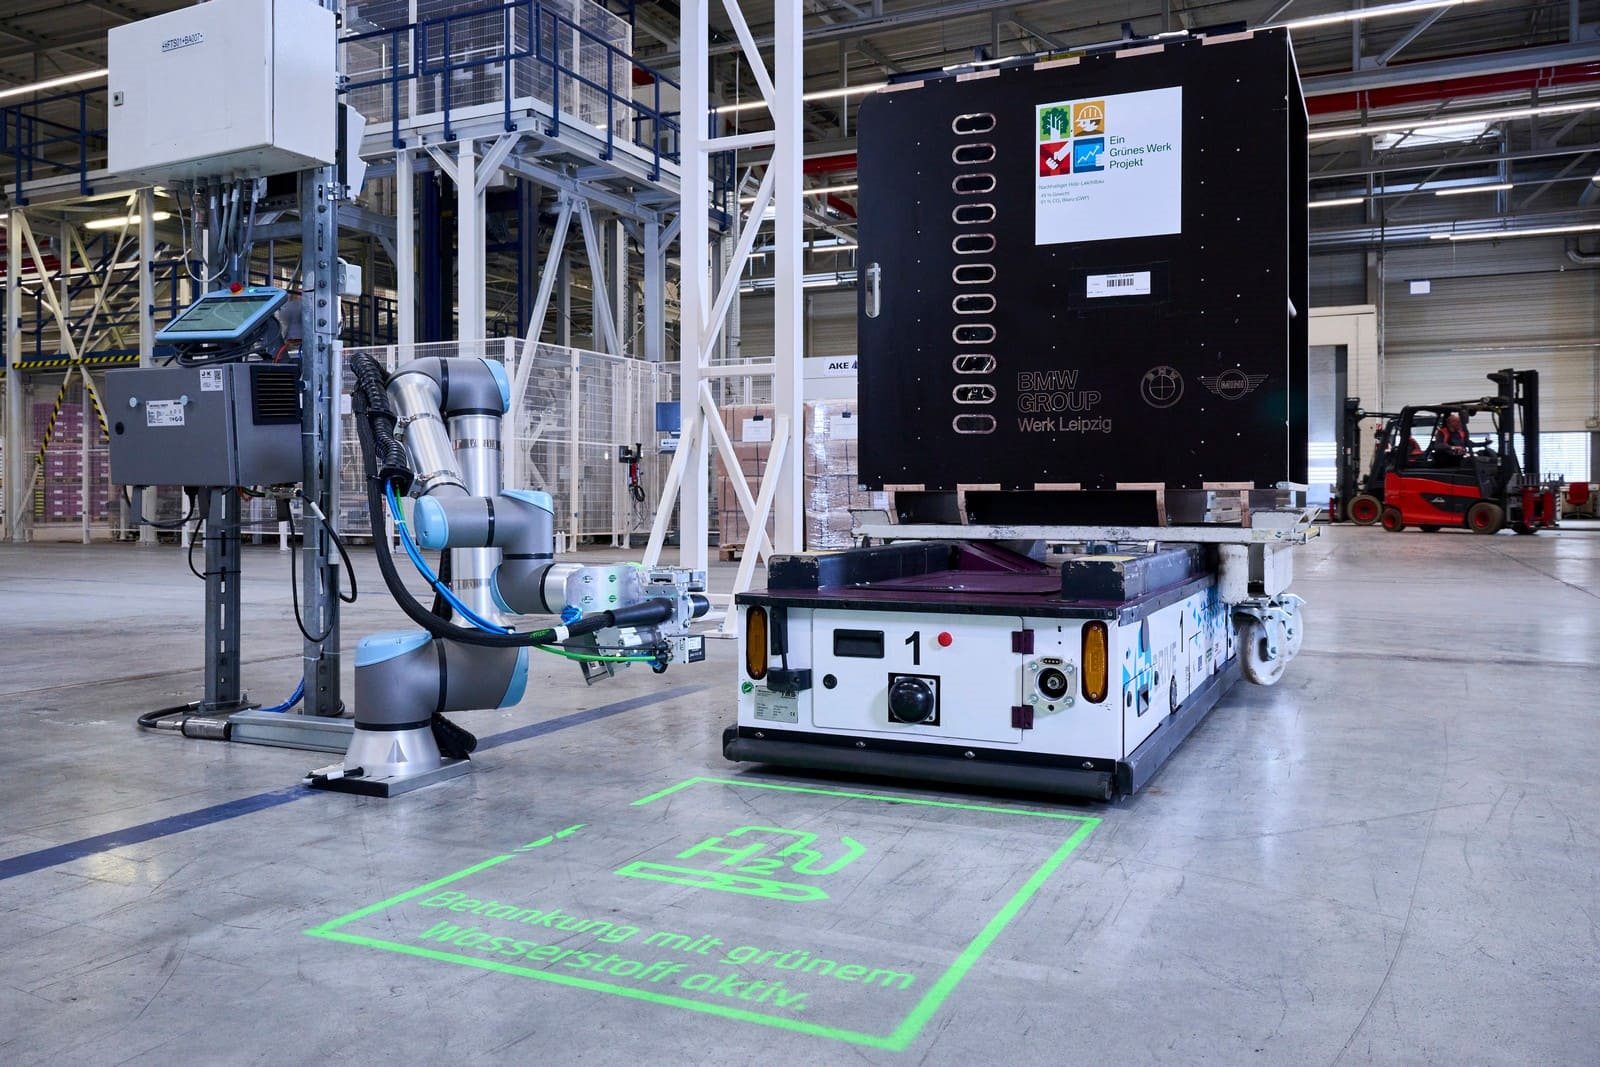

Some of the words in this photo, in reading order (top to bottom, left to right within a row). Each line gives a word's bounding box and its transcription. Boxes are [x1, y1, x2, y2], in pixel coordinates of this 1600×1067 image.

[1109, 135, 1125, 145] Ein
[1109, 146, 1145, 157] Grünes
[1146, 141, 1172, 153] Werk
[1109, 157, 1143, 170] Projekt
[828, 362, 849, 370] AKE
[1017, 370, 1079, 391] BMW
[1017, 391, 1102, 413] GROUP
[1017, 416, 1056, 432] Werk
[1059, 415, 1112, 434] Leipzig
[905, 631, 921, 665] 1
[418, 890, 640, 943] Betankung
[642, 931, 724, 954] mit
[719, 945, 917, 990] grünem
[418, 920, 689, 983] Wasserstoff
[680, 973, 809, 1011] aktiv.
